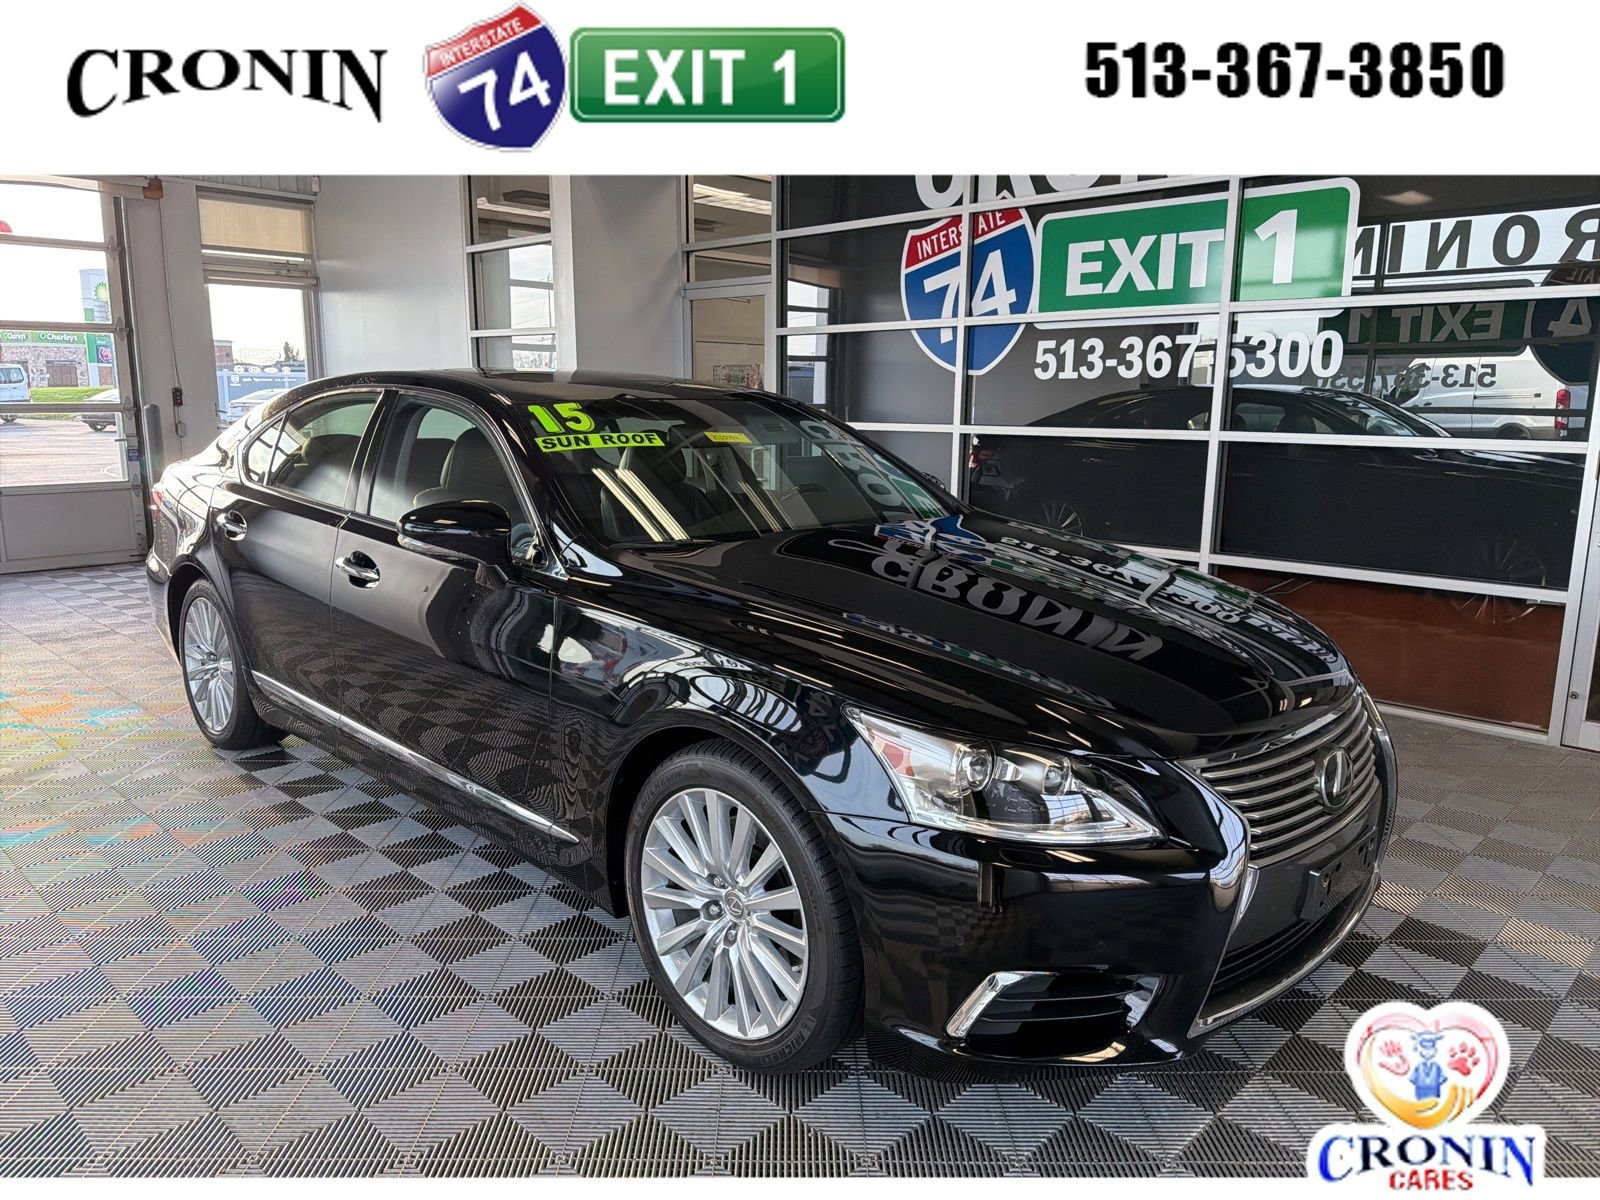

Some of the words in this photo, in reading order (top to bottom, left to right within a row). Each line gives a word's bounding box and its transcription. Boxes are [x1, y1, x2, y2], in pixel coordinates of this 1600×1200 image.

[917, 210, 1006, 260] INTERATE
[1066, 228, 1225, 297] EXIT
[1254, 209, 1299, 285] 1
[923, 249, 1018, 345] 74
[1034, 330, 1344, 380] 513-3675300
[528, 402, 596, 434] 15
[542, 433, 592, 451] SUN
[602, 433, 658, 446] ROOF
